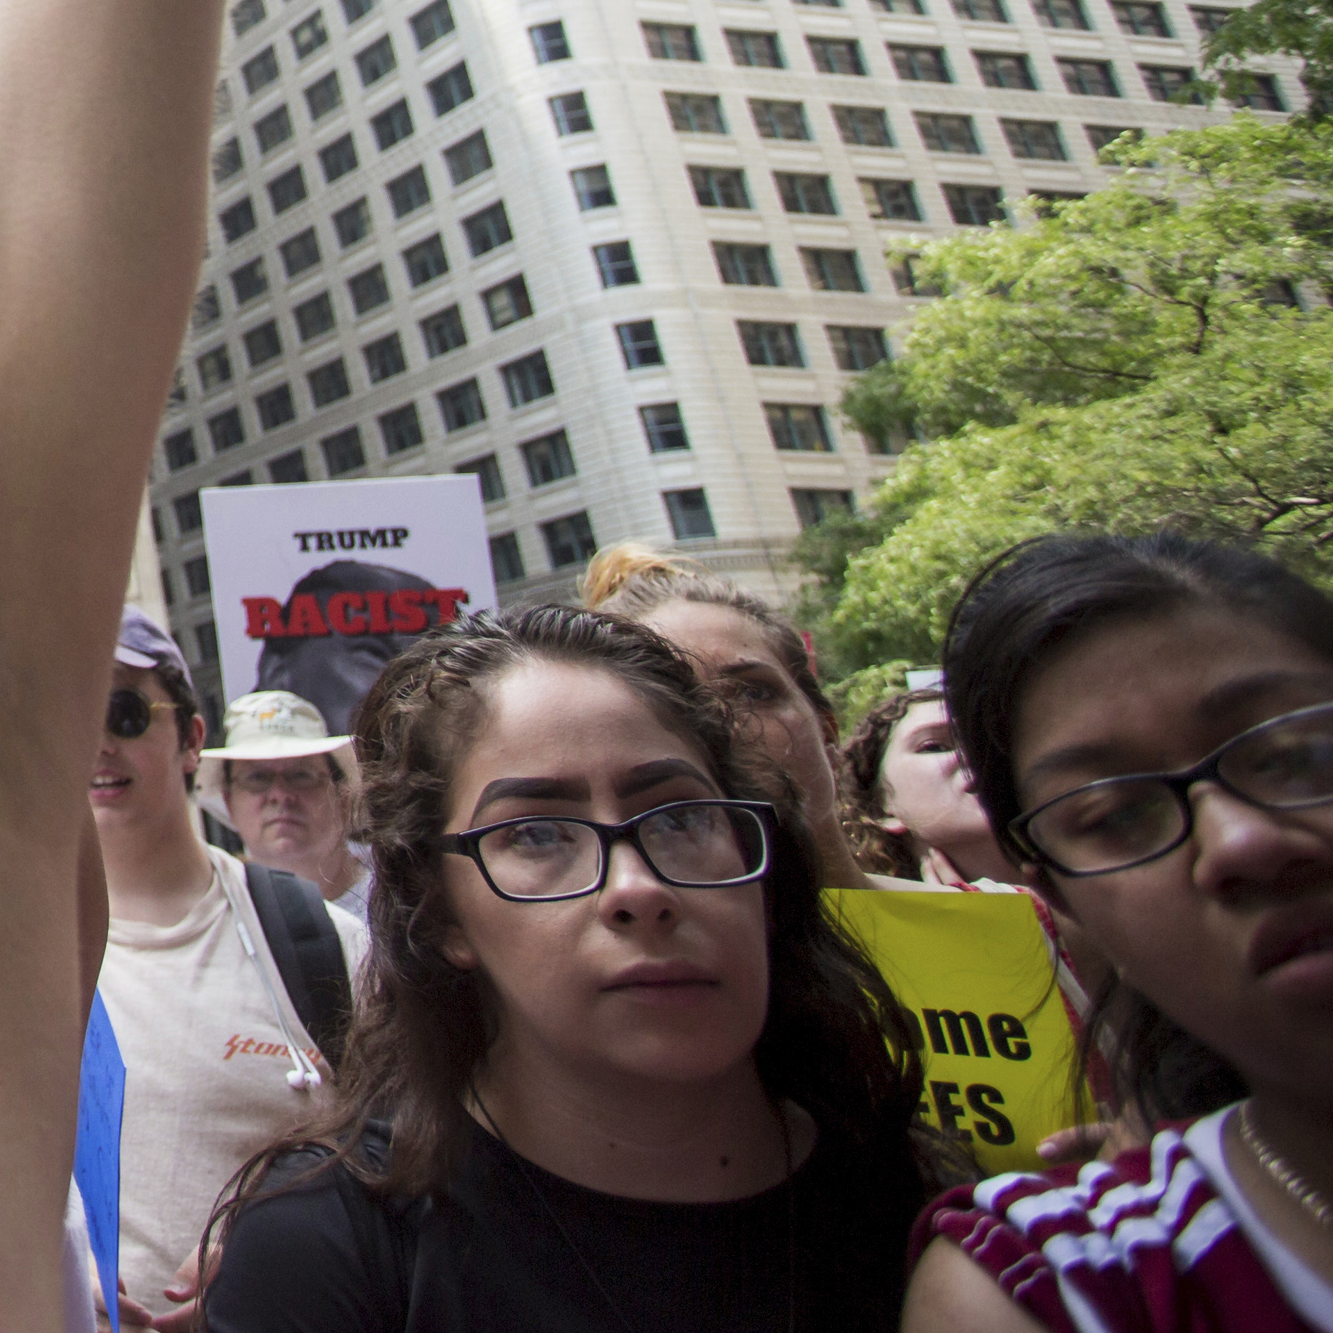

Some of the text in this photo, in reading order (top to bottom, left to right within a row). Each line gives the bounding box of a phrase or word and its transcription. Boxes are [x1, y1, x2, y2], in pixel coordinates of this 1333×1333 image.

[293, 527, 410, 552] TRUMP
[241, 587, 469, 640] RACIST
[222, 1033, 323, 1064] Stony
